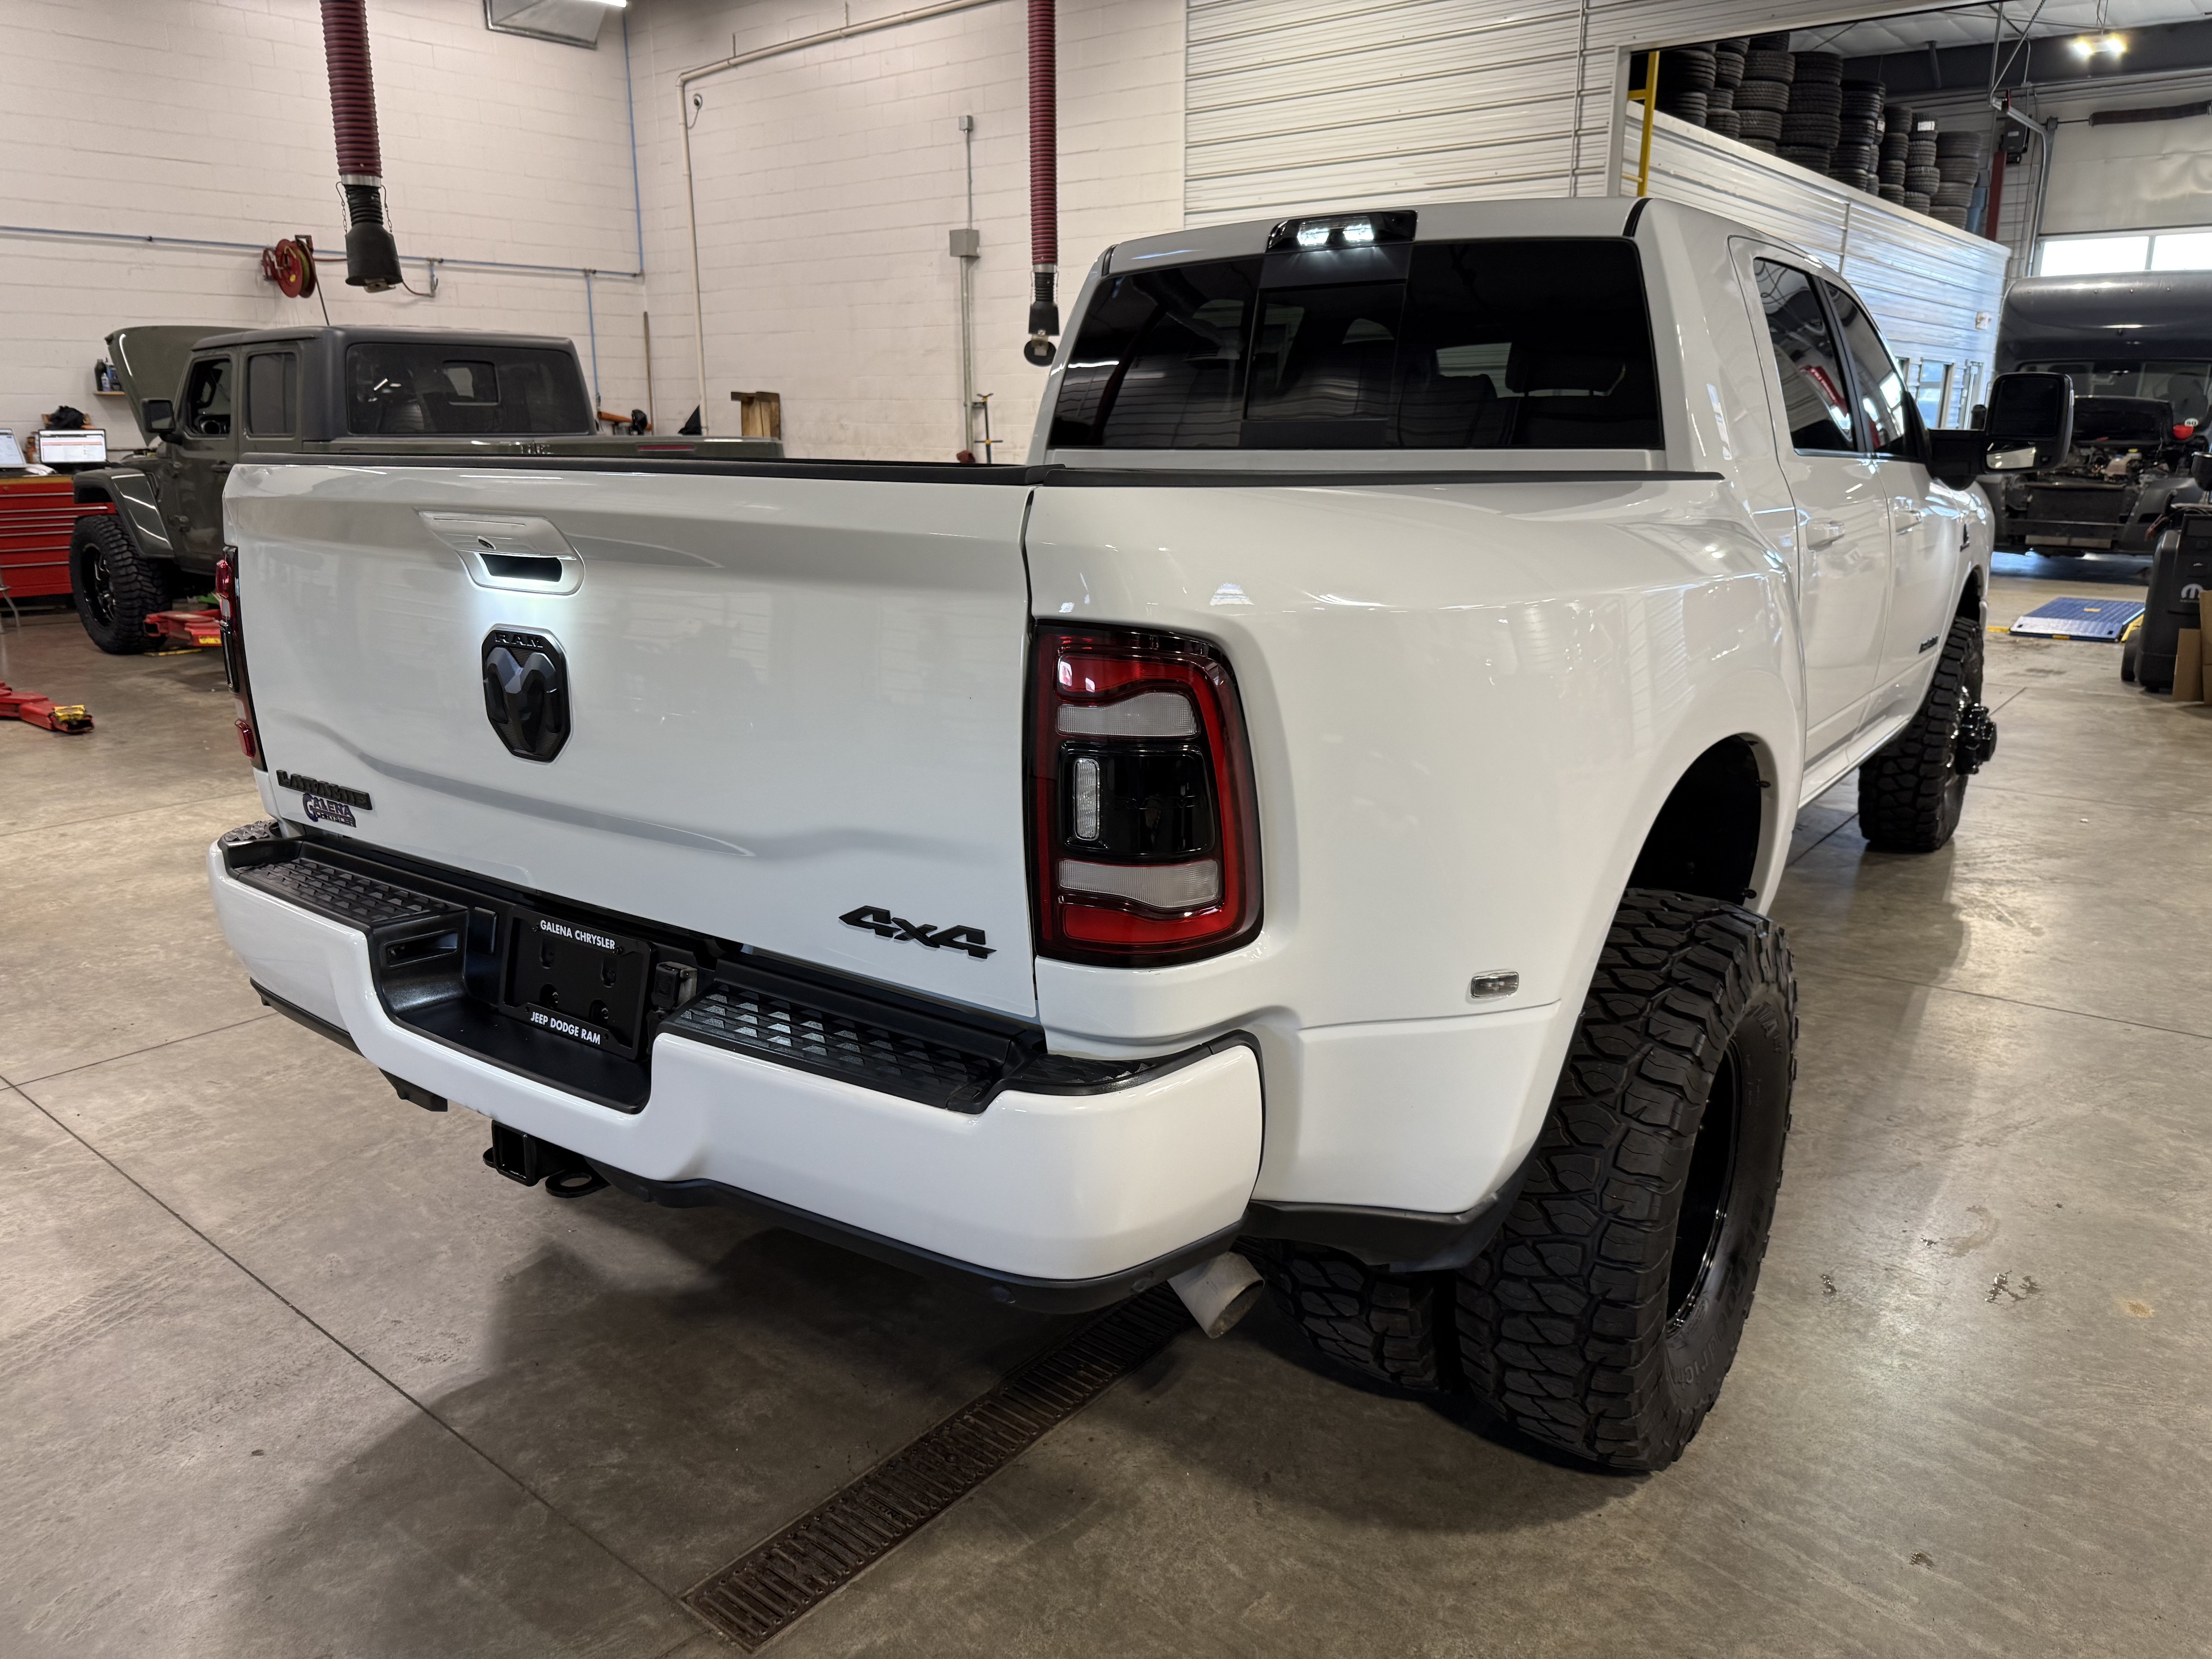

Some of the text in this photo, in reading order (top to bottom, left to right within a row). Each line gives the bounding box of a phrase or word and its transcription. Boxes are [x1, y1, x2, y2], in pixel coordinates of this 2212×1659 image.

[495, 632, 543, 648] RAM
[302, 793, 352, 822] GALENA
[540, 919, 615, 950] GALENA CHRYSLER
[531, 1012, 601, 1045] JEEP DODGE RAM
